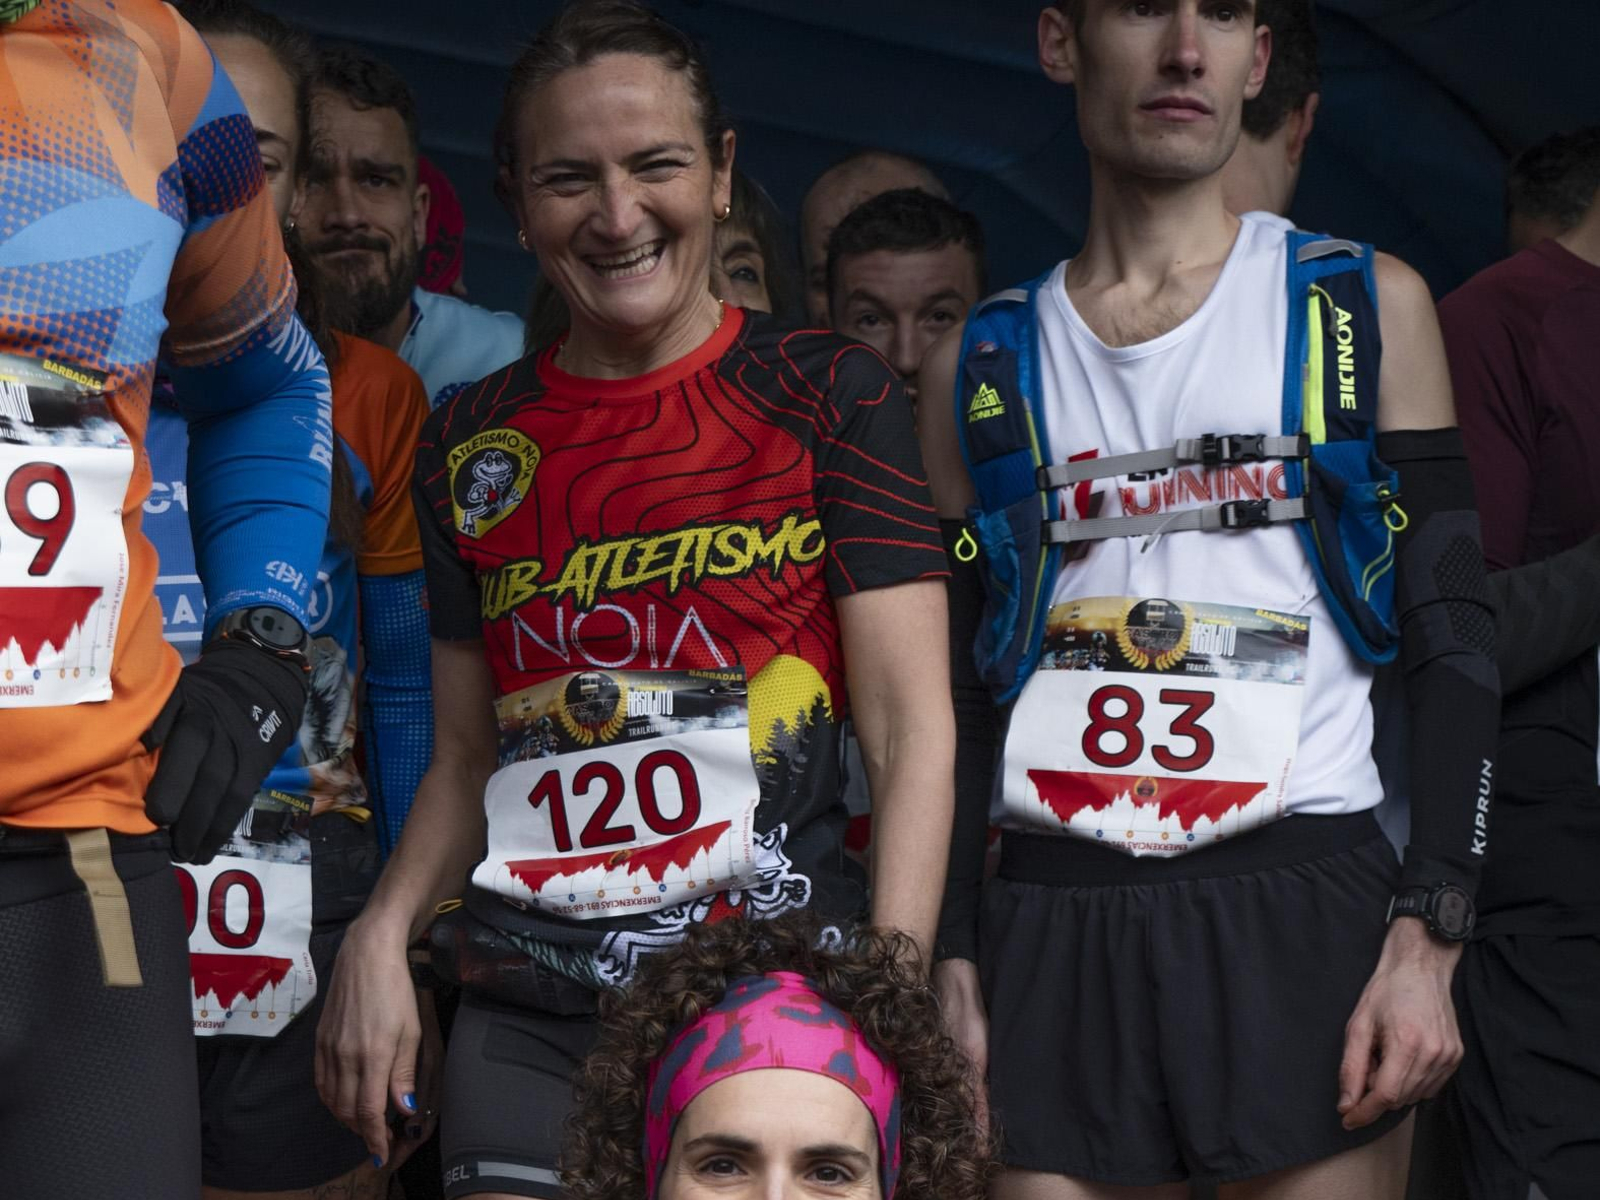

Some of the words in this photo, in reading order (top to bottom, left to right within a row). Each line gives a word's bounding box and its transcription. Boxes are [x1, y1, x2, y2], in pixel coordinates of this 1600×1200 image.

[1334, 306, 1357, 411] AONIJIE
[451, 431, 521, 466] ATLETISMO
[0, 460, 76, 577] 9
[534, 513, 827, 609] ATLETISMO
[510, 603, 729, 671] NOIA
[1081, 684, 1215, 773] 83
[527, 749, 702, 853] 120
[1470, 758, 1495, 856] KIPRUN
[600, 895, 662, 915] EMERXENCIAS
